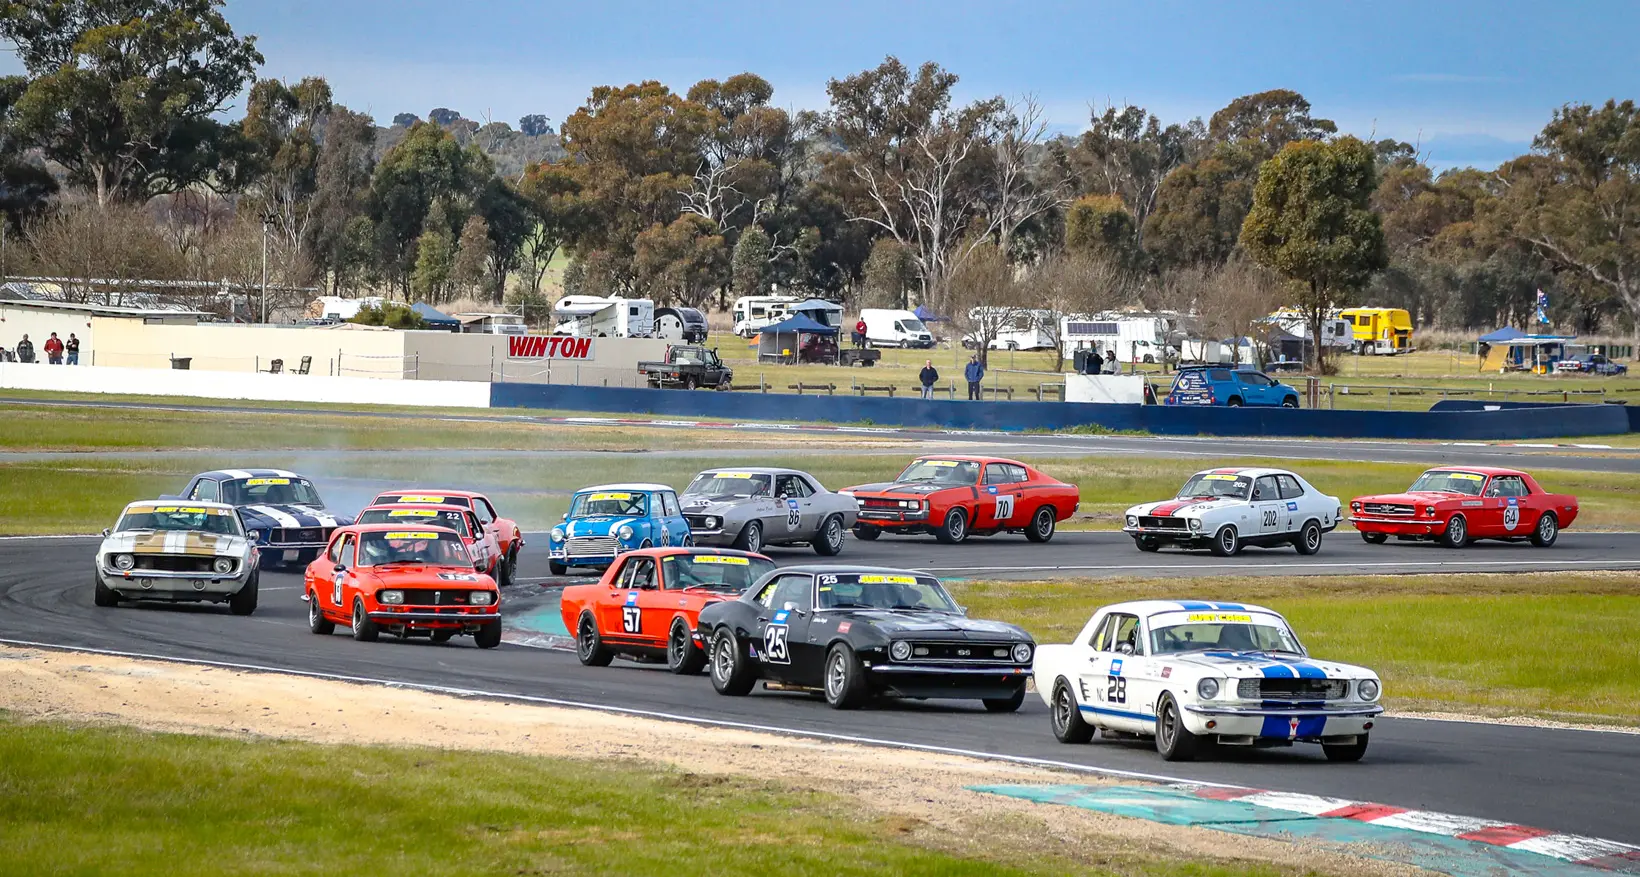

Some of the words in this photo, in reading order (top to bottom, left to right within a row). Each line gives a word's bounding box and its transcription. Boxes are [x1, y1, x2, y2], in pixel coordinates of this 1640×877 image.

[509, 336, 592, 358] WINTON
[1233, 481, 1247, 489] 202
[446, 512, 460, 520] 22
[788, 509, 800, 526] 86
[997, 500, 1009, 519] 70
[1505, 509, 1516, 525] 64
[1263, 510, 1277, 527] 202
[451, 543, 462, 552] 13
[821, 575, 839, 585] 25
[622, 606, 640, 633] 57
[1187, 613, 1217, 623] JUST
[1217, 613, 1253, 623] CARS
[766, 631, 786, 660] 25
[1107, 675, 1126, 704] 28
